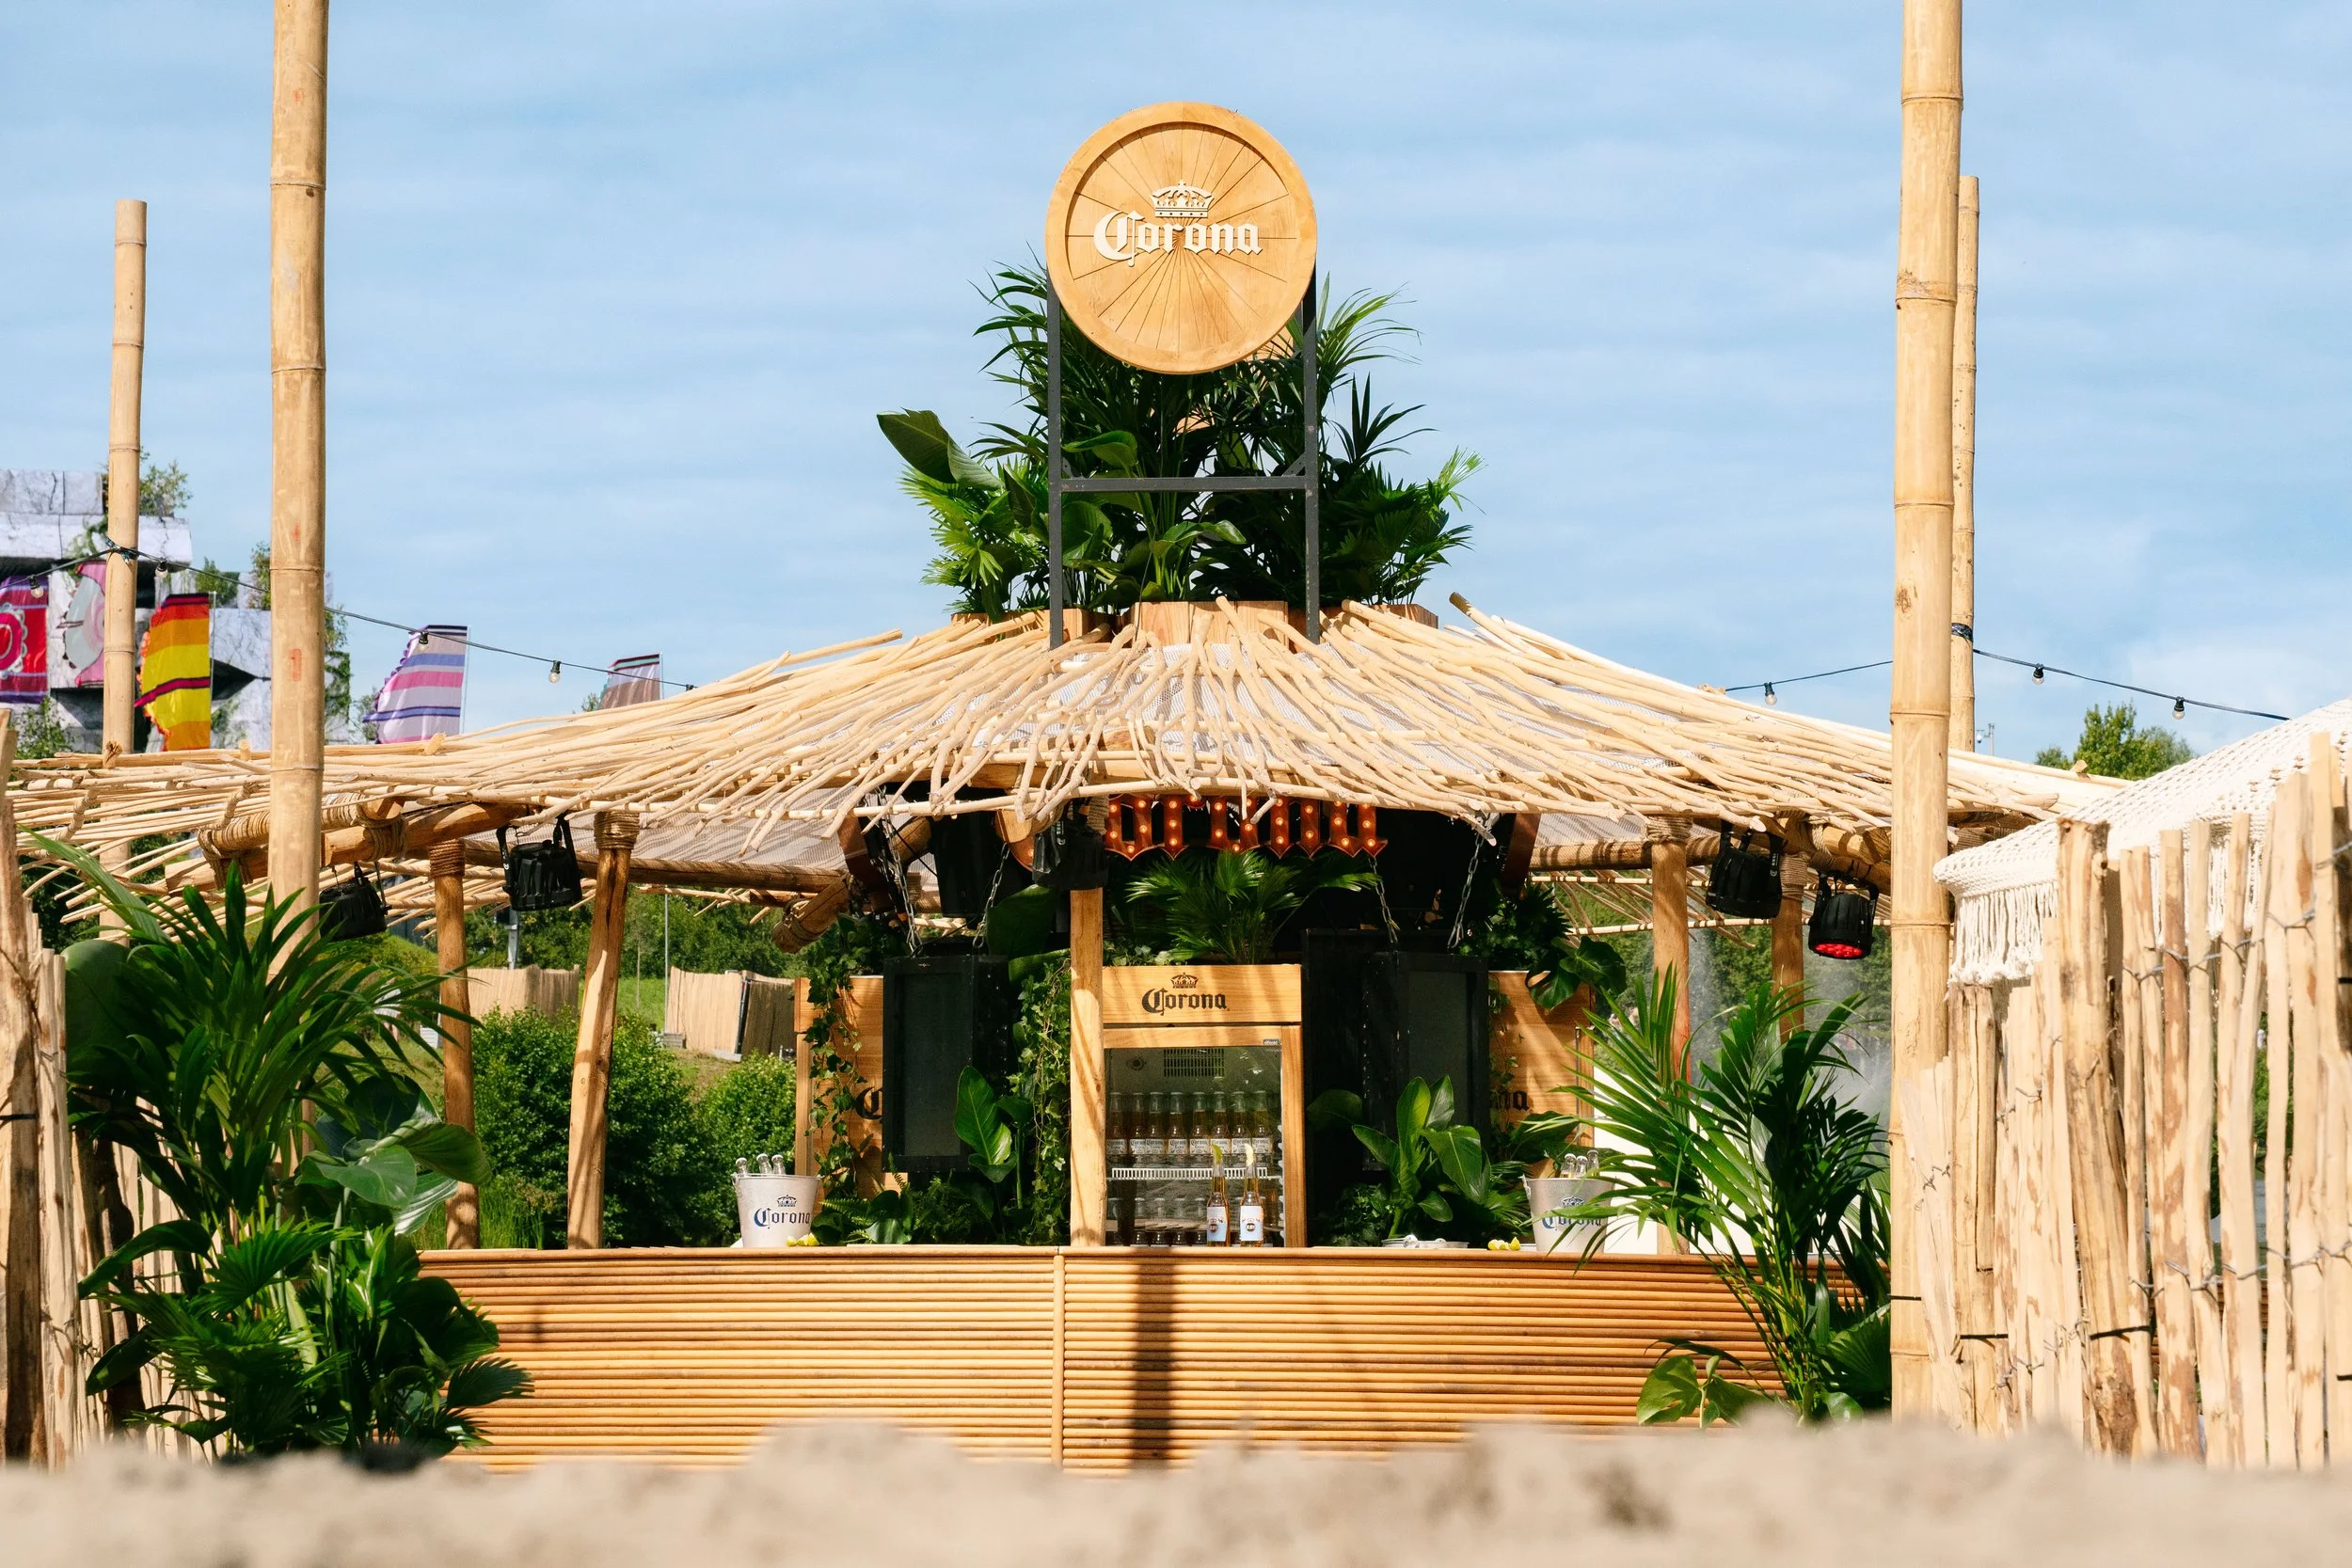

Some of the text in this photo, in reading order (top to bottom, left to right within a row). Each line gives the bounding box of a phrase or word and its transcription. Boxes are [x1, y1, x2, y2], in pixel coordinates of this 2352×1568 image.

[1093, 210, 1263, 267] Corona
[1141, 987, 1228, 1016] Corona
[754, 1207, 811, 1229] Corona
